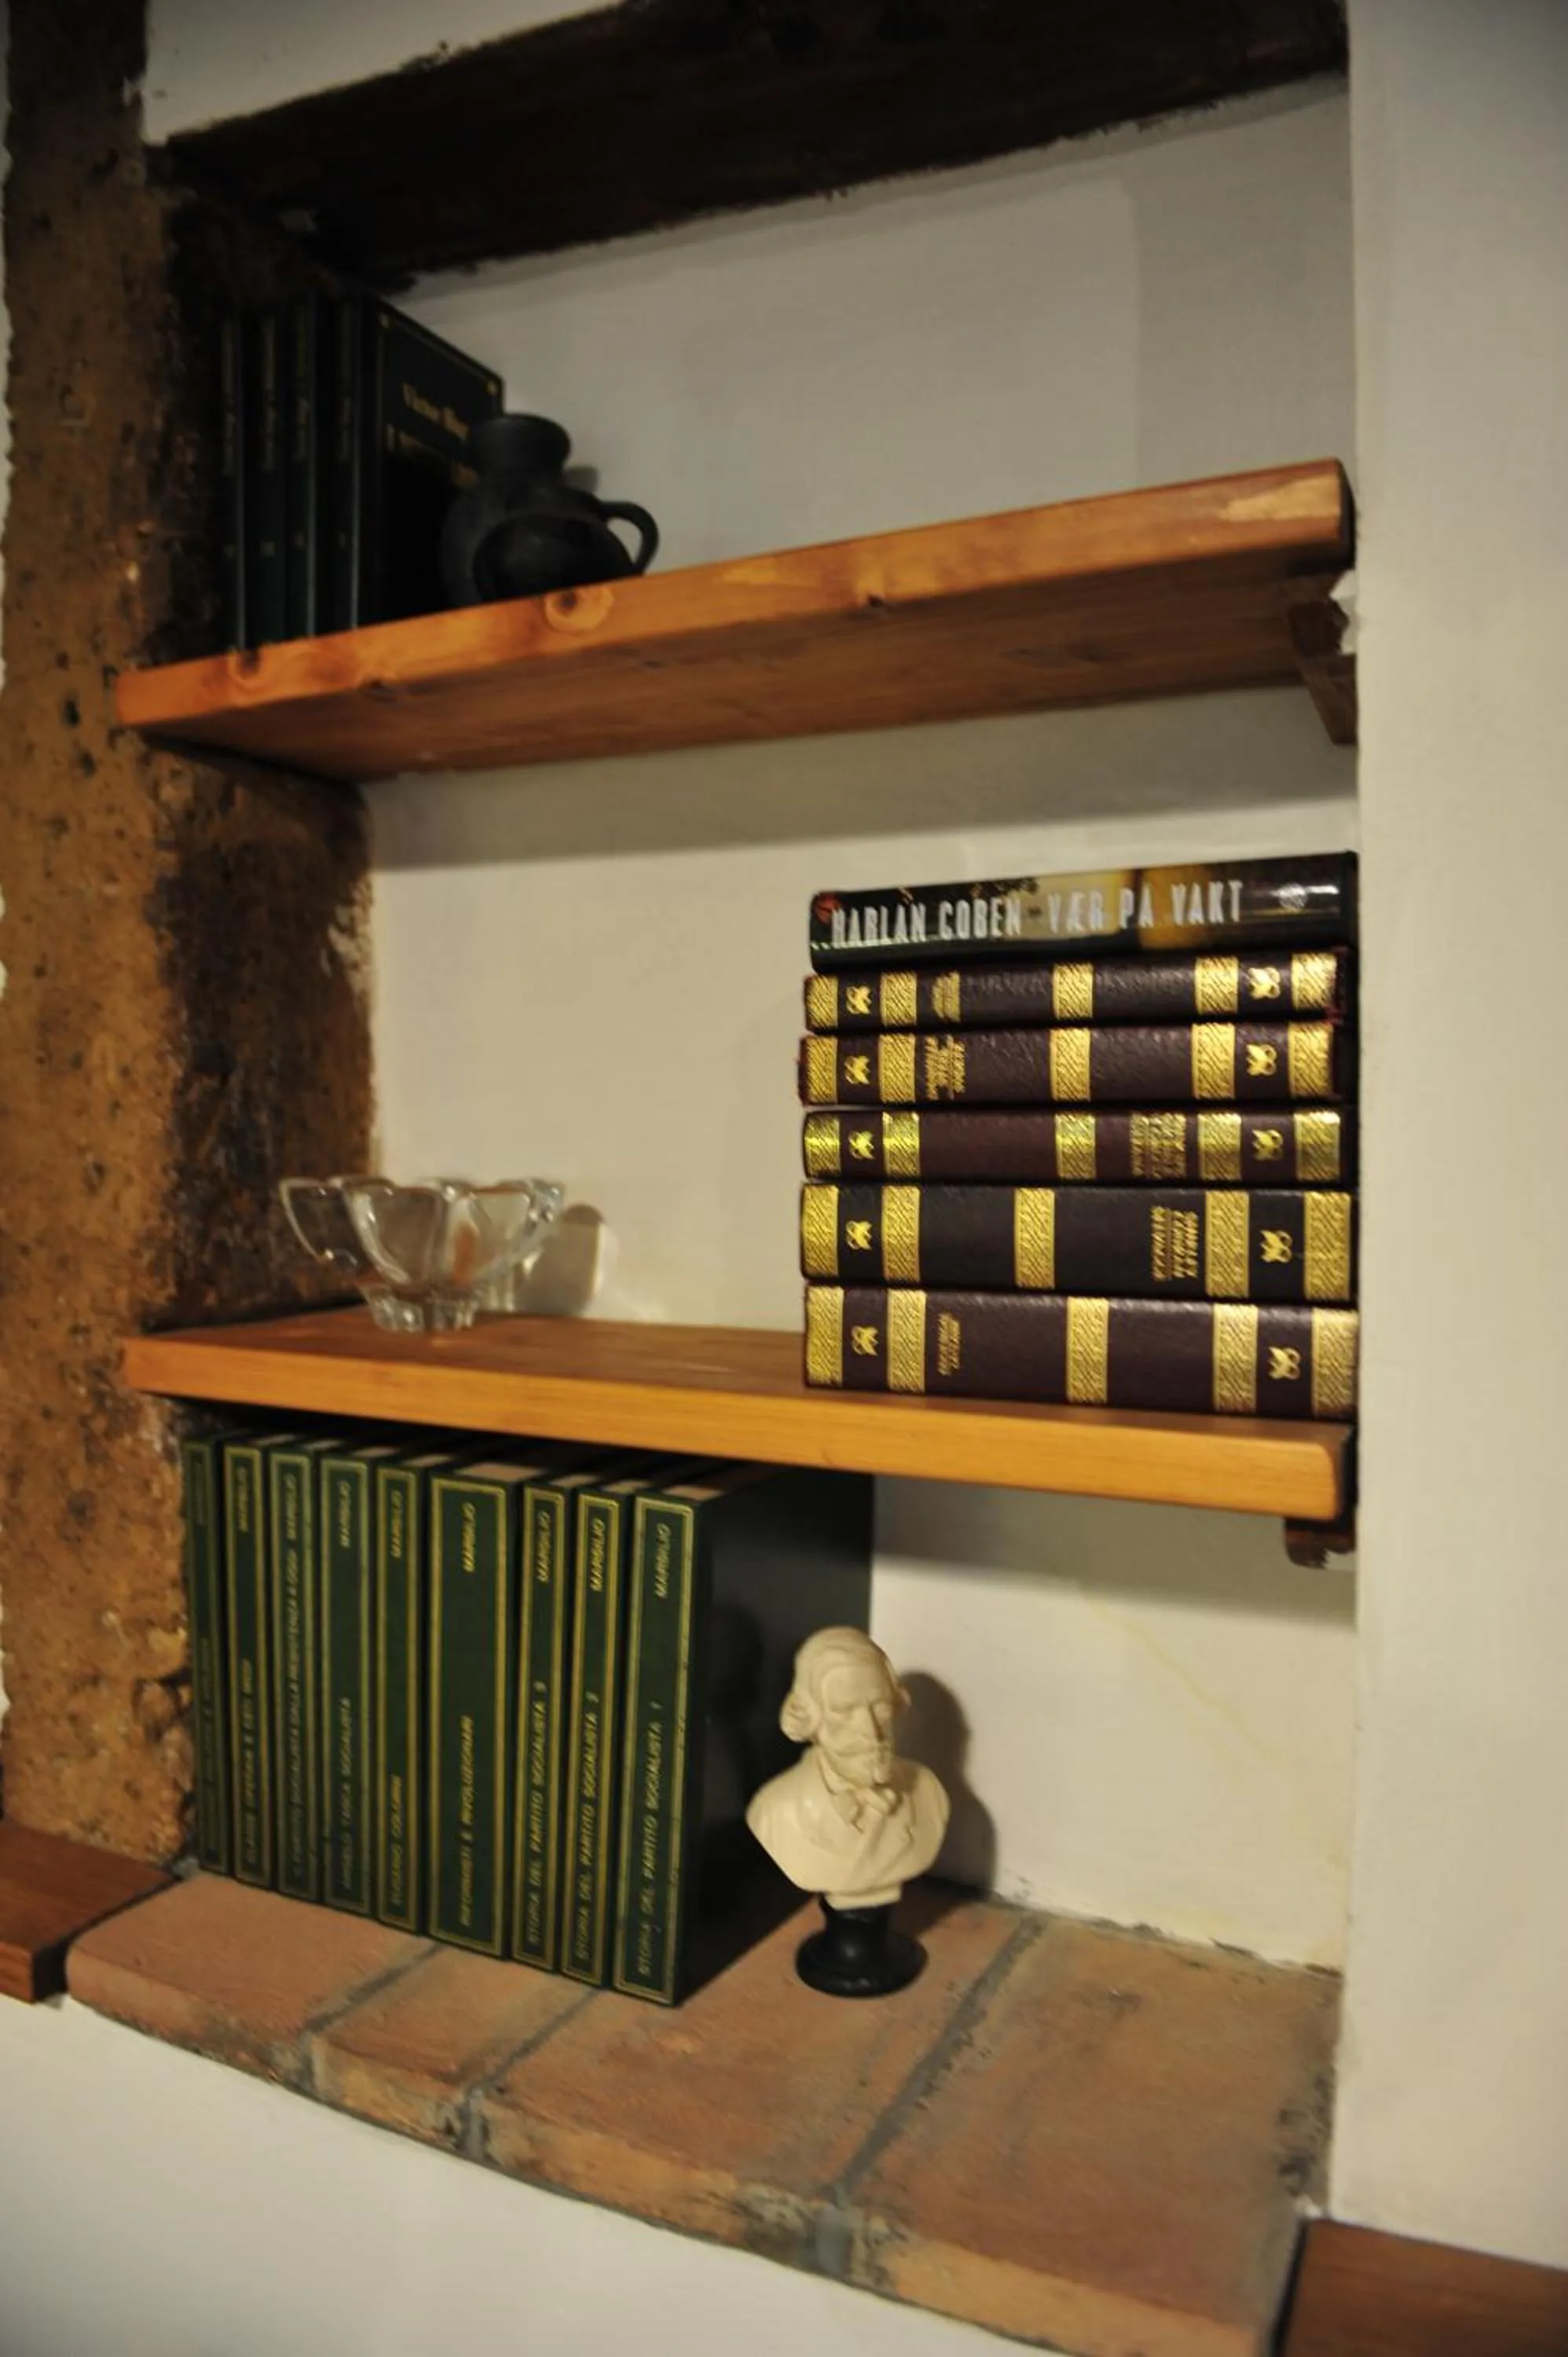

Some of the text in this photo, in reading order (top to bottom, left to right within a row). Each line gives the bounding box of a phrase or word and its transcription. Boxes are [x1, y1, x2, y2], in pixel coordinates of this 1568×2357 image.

[830, 895, 1021, 949] HARLAN COBEN
[1048, 889, 1103, 933] VÆR
[1171, 879, 1243, 927] VAKT
[589, 1516, 606, 1593] MARSILIO
[653, 1522, 671, 1599] MARSILIO
[532, 1701, 547, 1787] SOCIALISTA
[583, 1713, 599, 1799] SOCIALISTA
[645, 1721, 664, 1811] SOCIALISTA
[529, 1791, 545, 1853] PARTITO
[580, 1805, 595, 1867] PARTITO
[642, 1815, 658, 1881] PARTITO
